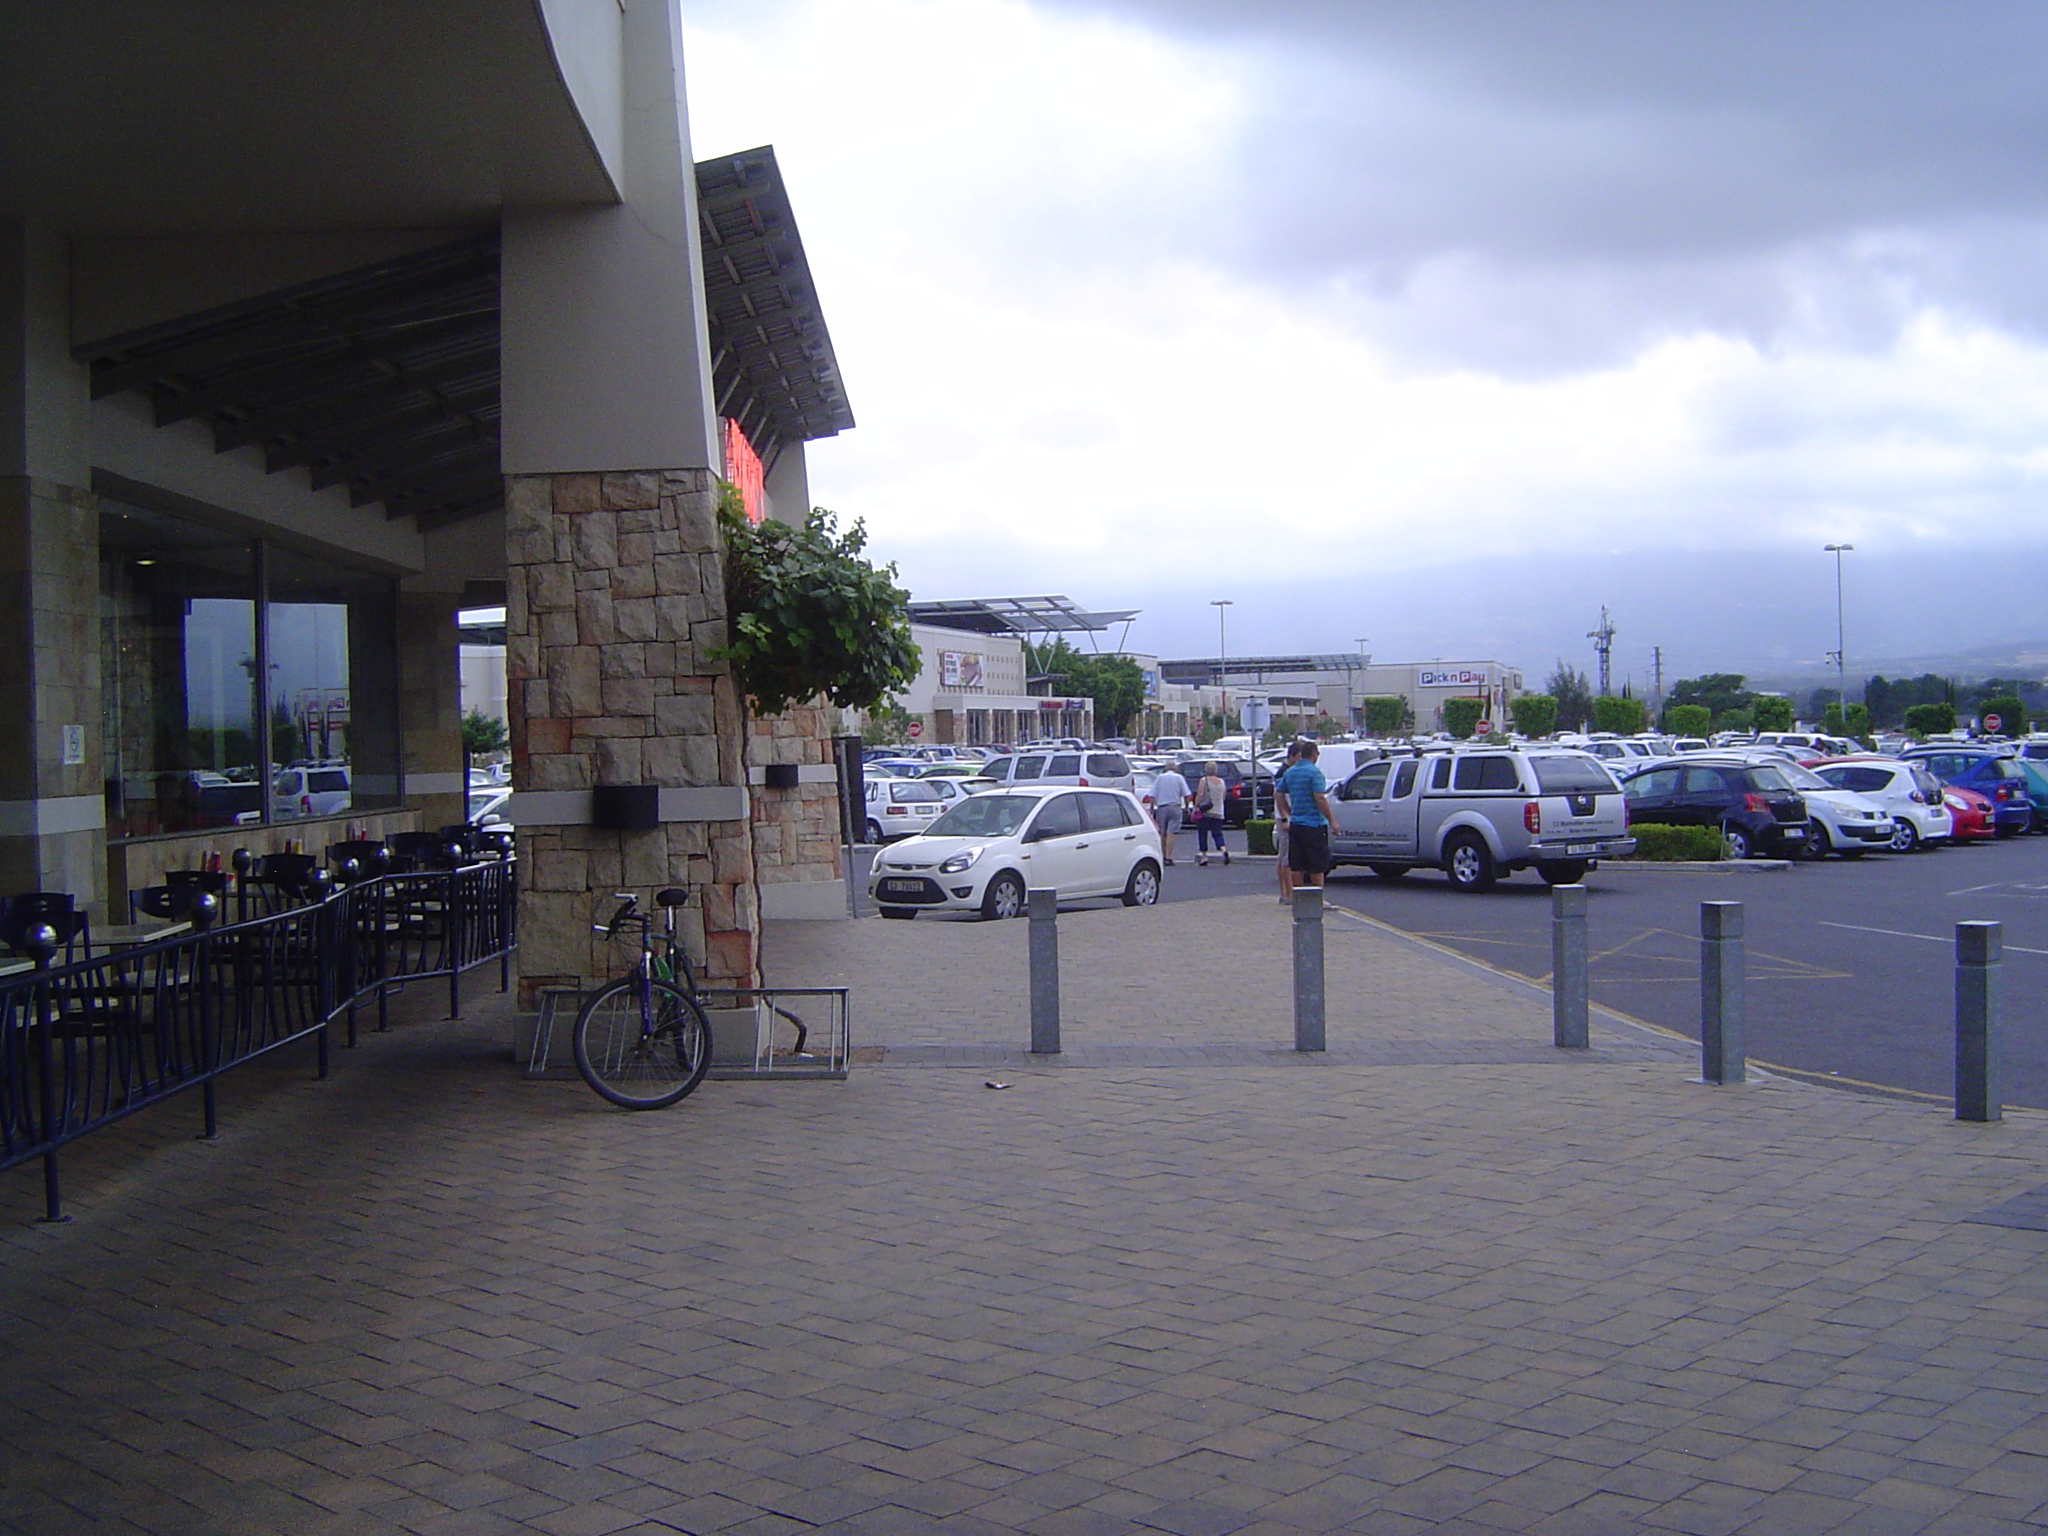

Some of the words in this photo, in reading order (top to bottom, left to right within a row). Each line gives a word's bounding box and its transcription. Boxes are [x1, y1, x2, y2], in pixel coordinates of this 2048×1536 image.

[1422, 672, 1449, 684] Pick
[1450, 674, 1457, 682] n
[1459, 671, 1485, 683] Pay
